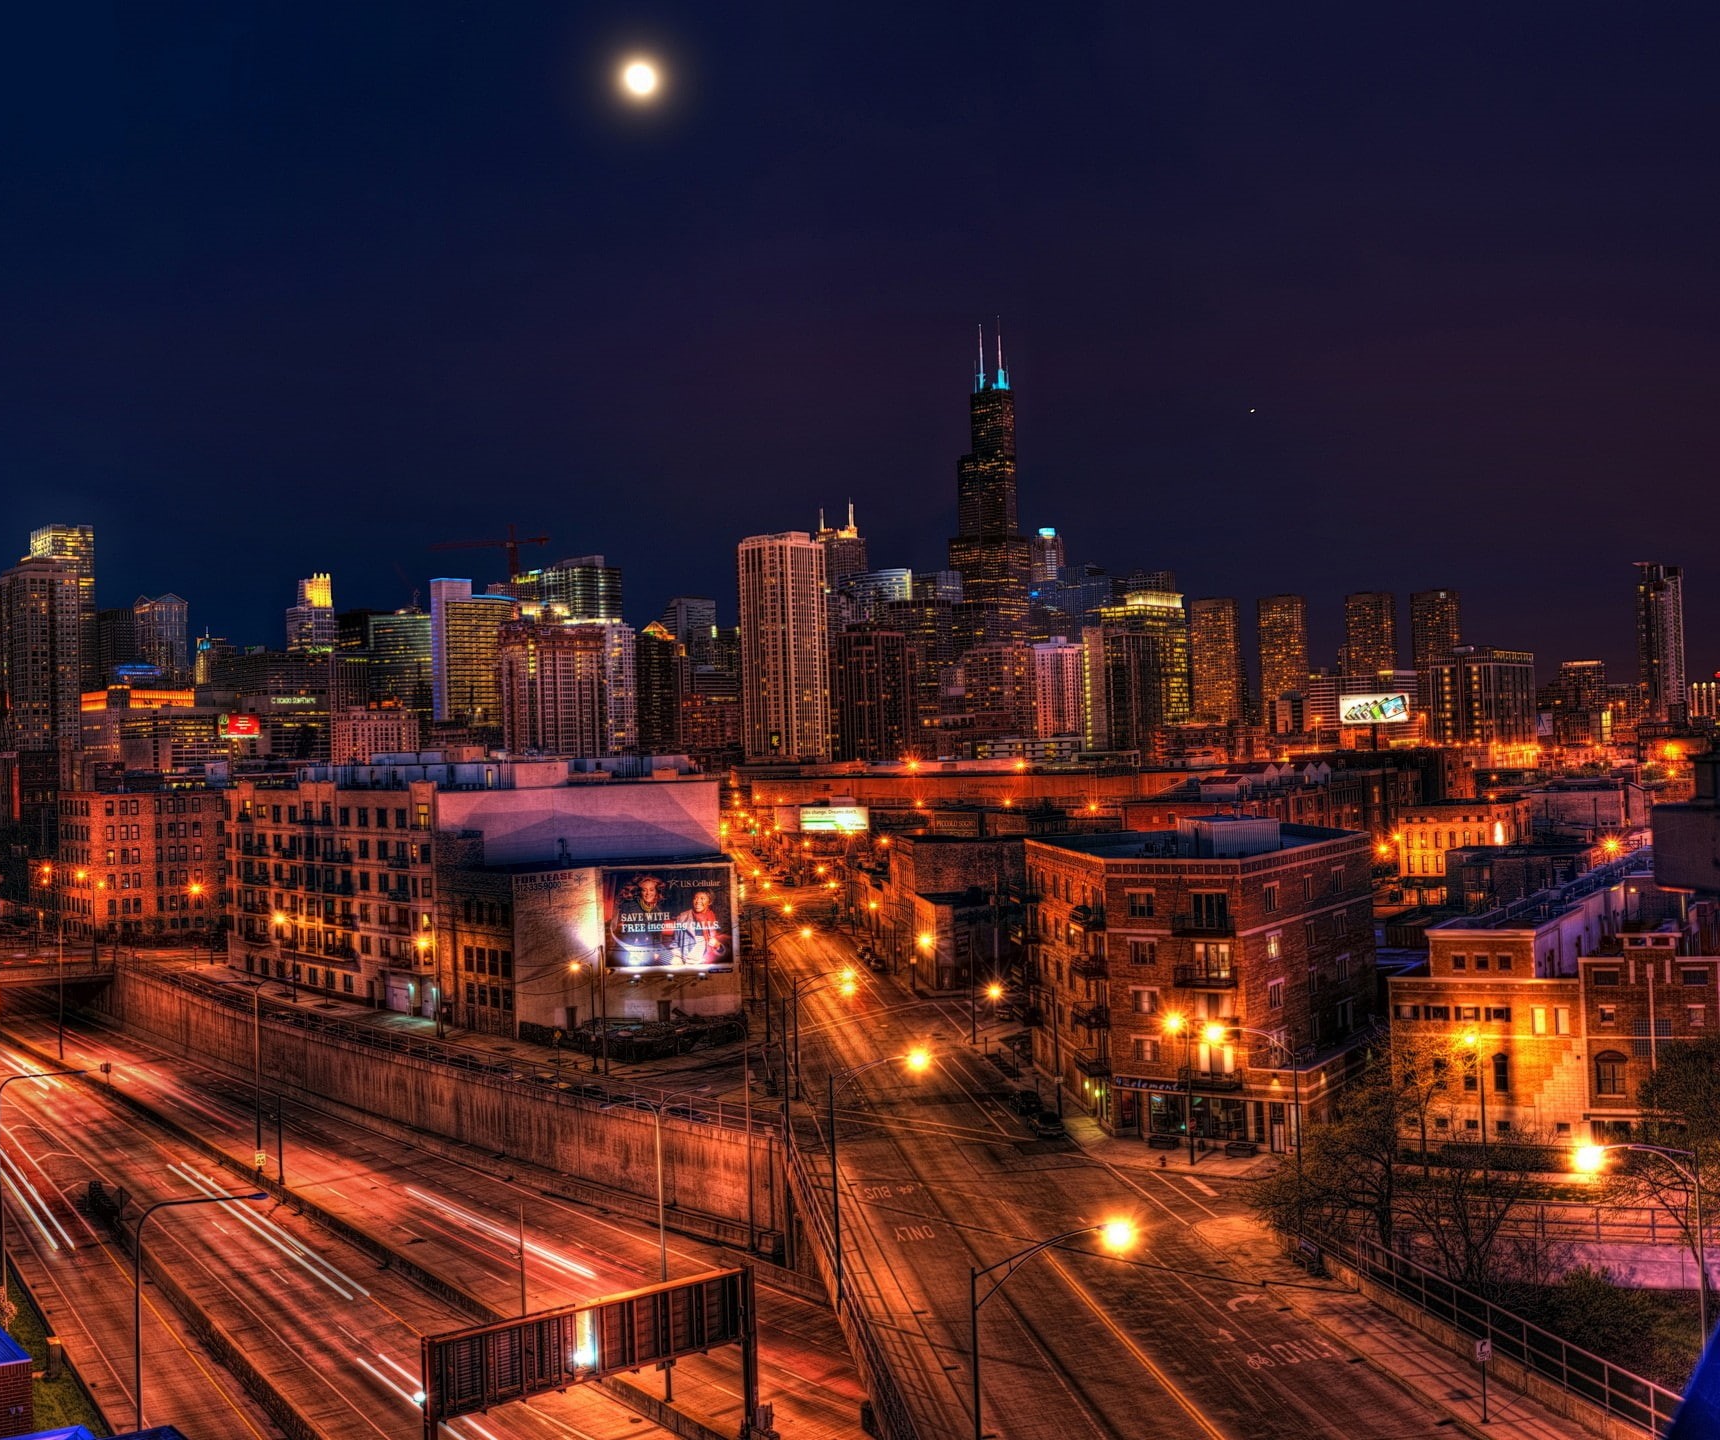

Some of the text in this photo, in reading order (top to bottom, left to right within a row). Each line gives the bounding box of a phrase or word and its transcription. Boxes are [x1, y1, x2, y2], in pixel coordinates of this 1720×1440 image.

[515, 875, 537, 884] FOR
[540, 872, 574, 882] LEASE
[692, 879, 721, 888] Cellular
[621, 912, 670, 922] SAVE WITH
[621, 923, 646, 932] FREE
[647, 921, 688, 931] incoming
[864, 1185, 893, 1200] BUS
[894, 1225, 935, 1242] ONLY
